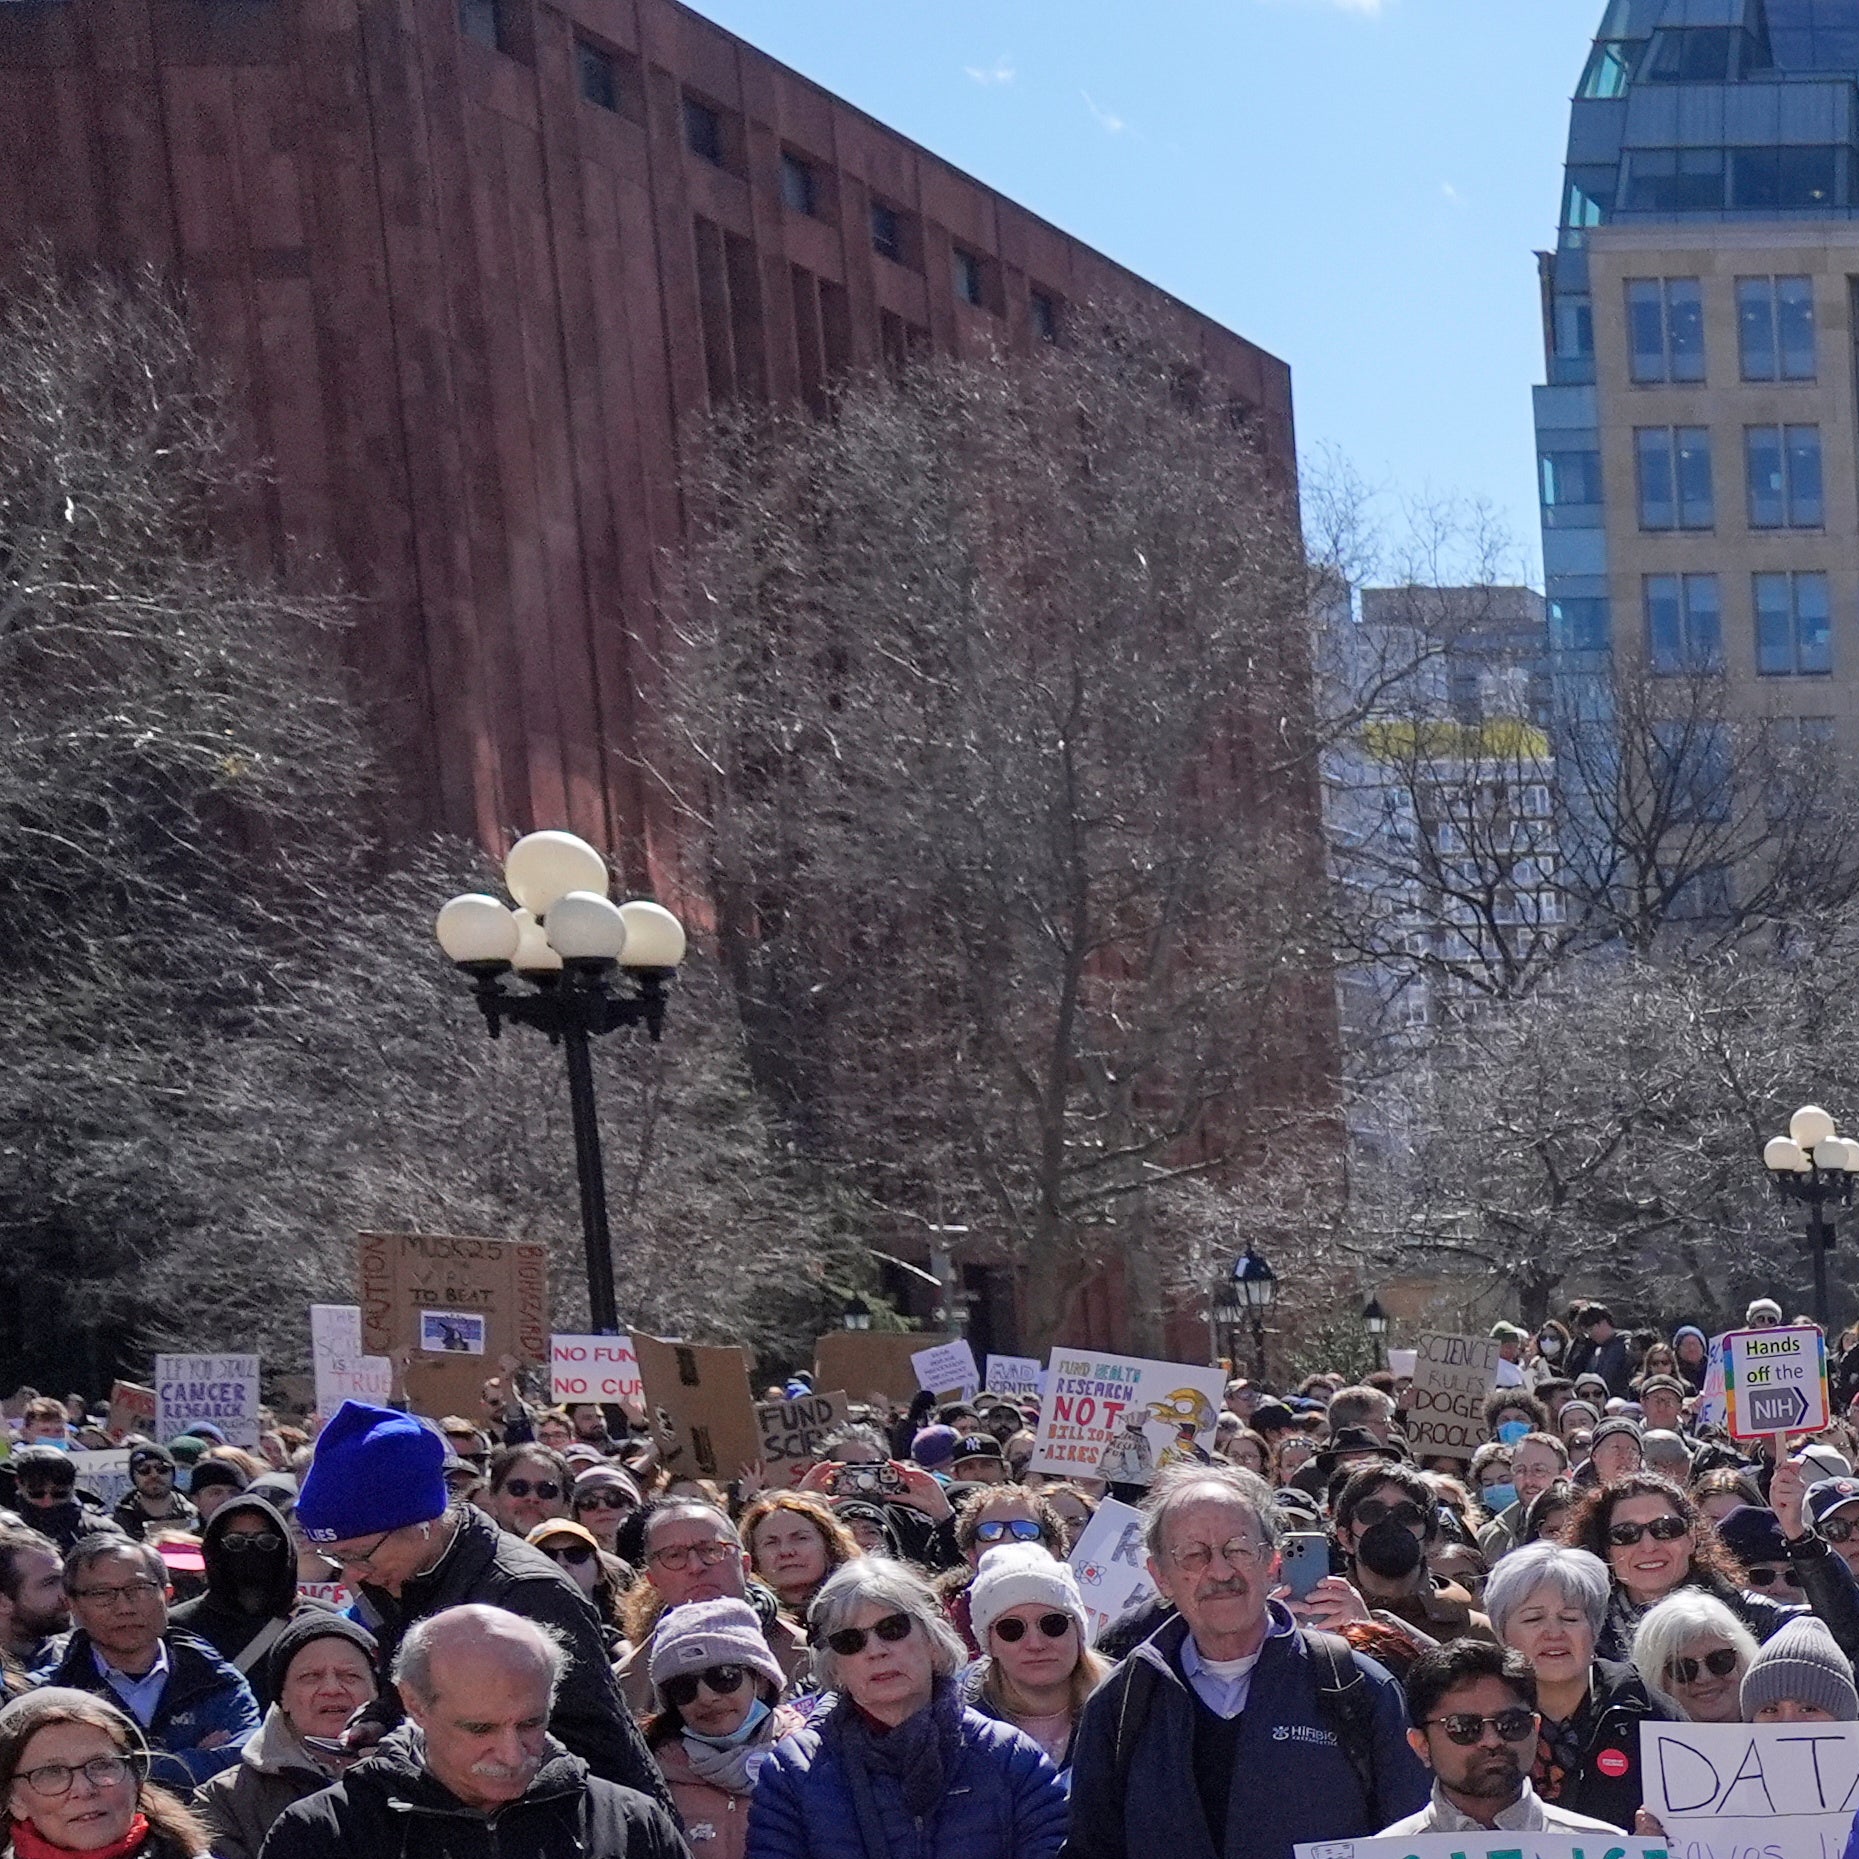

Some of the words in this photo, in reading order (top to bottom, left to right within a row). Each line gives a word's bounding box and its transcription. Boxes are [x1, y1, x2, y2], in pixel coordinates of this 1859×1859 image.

[359, 1232, 391, 1350] CAUTION
[446, 1288, 495, 1301] BEAT
[554, 1347, 586, 1361] NO
[1417, 1333, 1499, 1371] SCIENCE
[1746, 1336, 1800, 1356] Hands
[1428, 1370, 1484, 1395] RULES
[1747, 1365, 1770, 1383] off
[1775, 1364, 1803, 1381] the
[161, 1382, 246, 1402] CANCER
[554, 1379, 587, 1394] NO
[1056, 1378, 1133, 1400] RESEARCH
[163, 1403, 244, 1418] RESEARCH
[1053, 1395, 1125, 1429] NOT
[1416, 1389, 1483, 1420] DOGE
[1754, 1398, 1793, 1419] NIH
[759, 1399, 833, 1433] FUND
[1406, 1421, 1488, 1448] DROOLS
